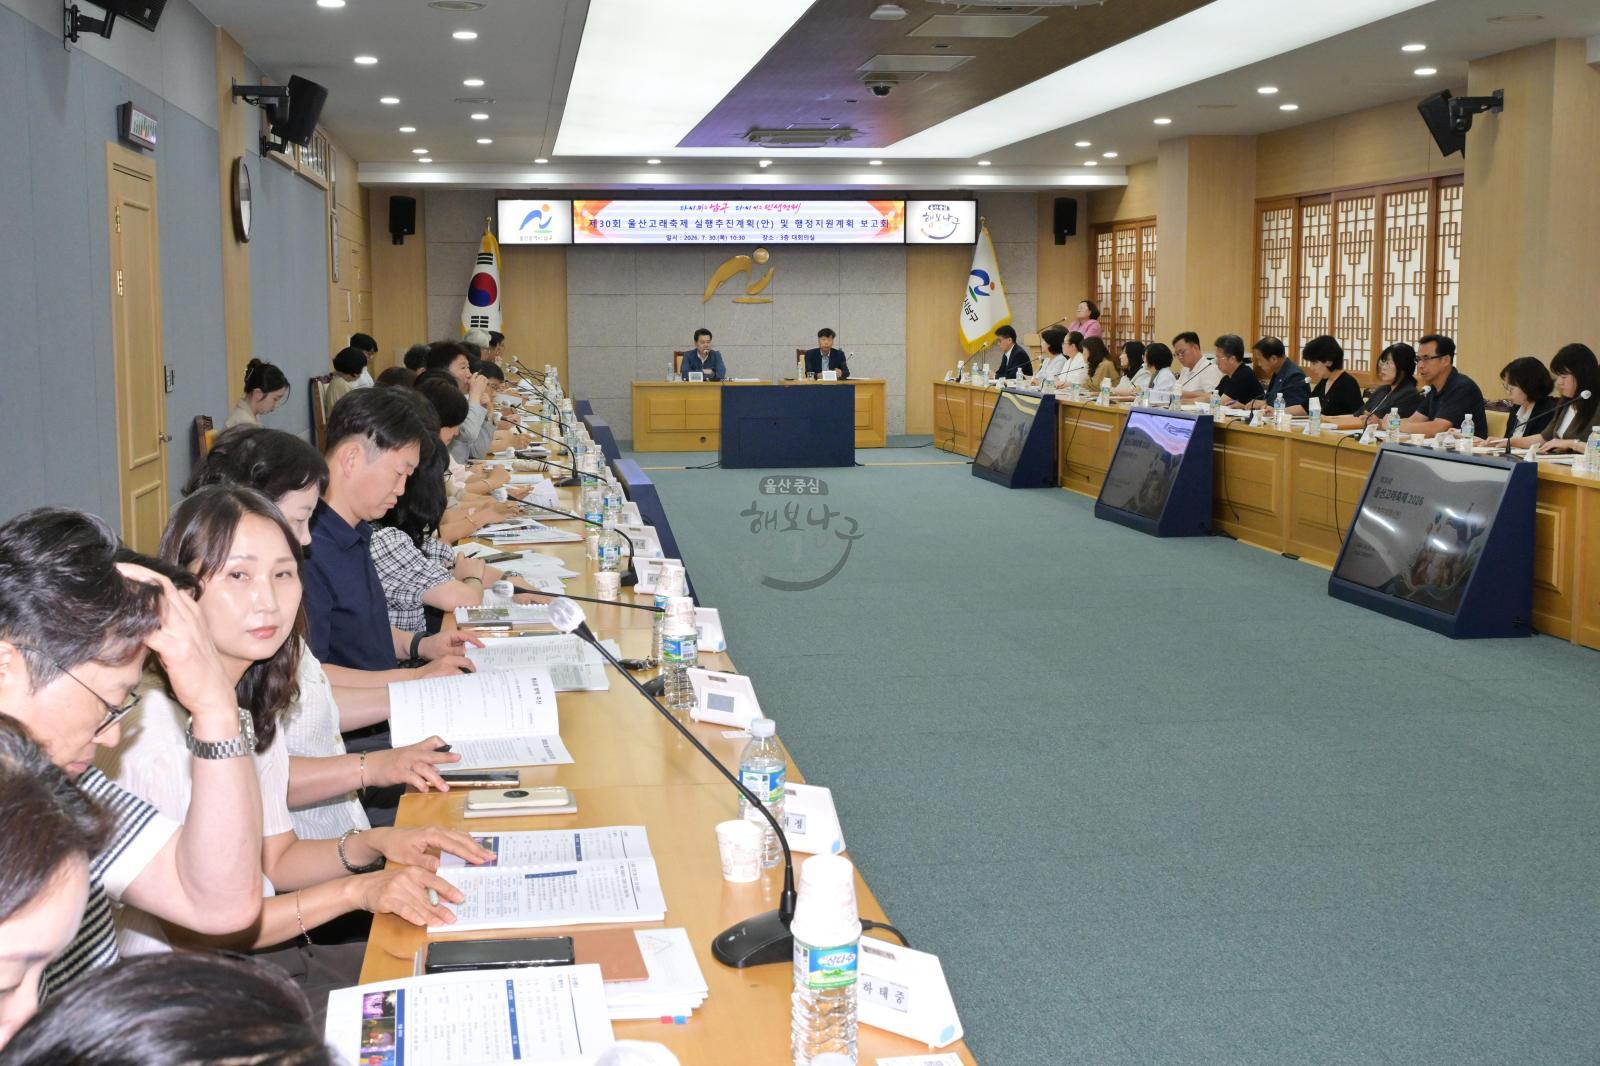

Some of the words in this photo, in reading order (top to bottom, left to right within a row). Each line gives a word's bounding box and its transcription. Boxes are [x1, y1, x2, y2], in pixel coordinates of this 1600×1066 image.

[588, 218, 621, 229] 제30회
[627, 218, 689, 229] 울산고래축제
[694, 218, 775, 229] 실행추진계획(안)
[780, 219, 789, 229] 및
[794, 218, 854, 229] 행정지원계획
[860, 218, 889, 229] 보고회
